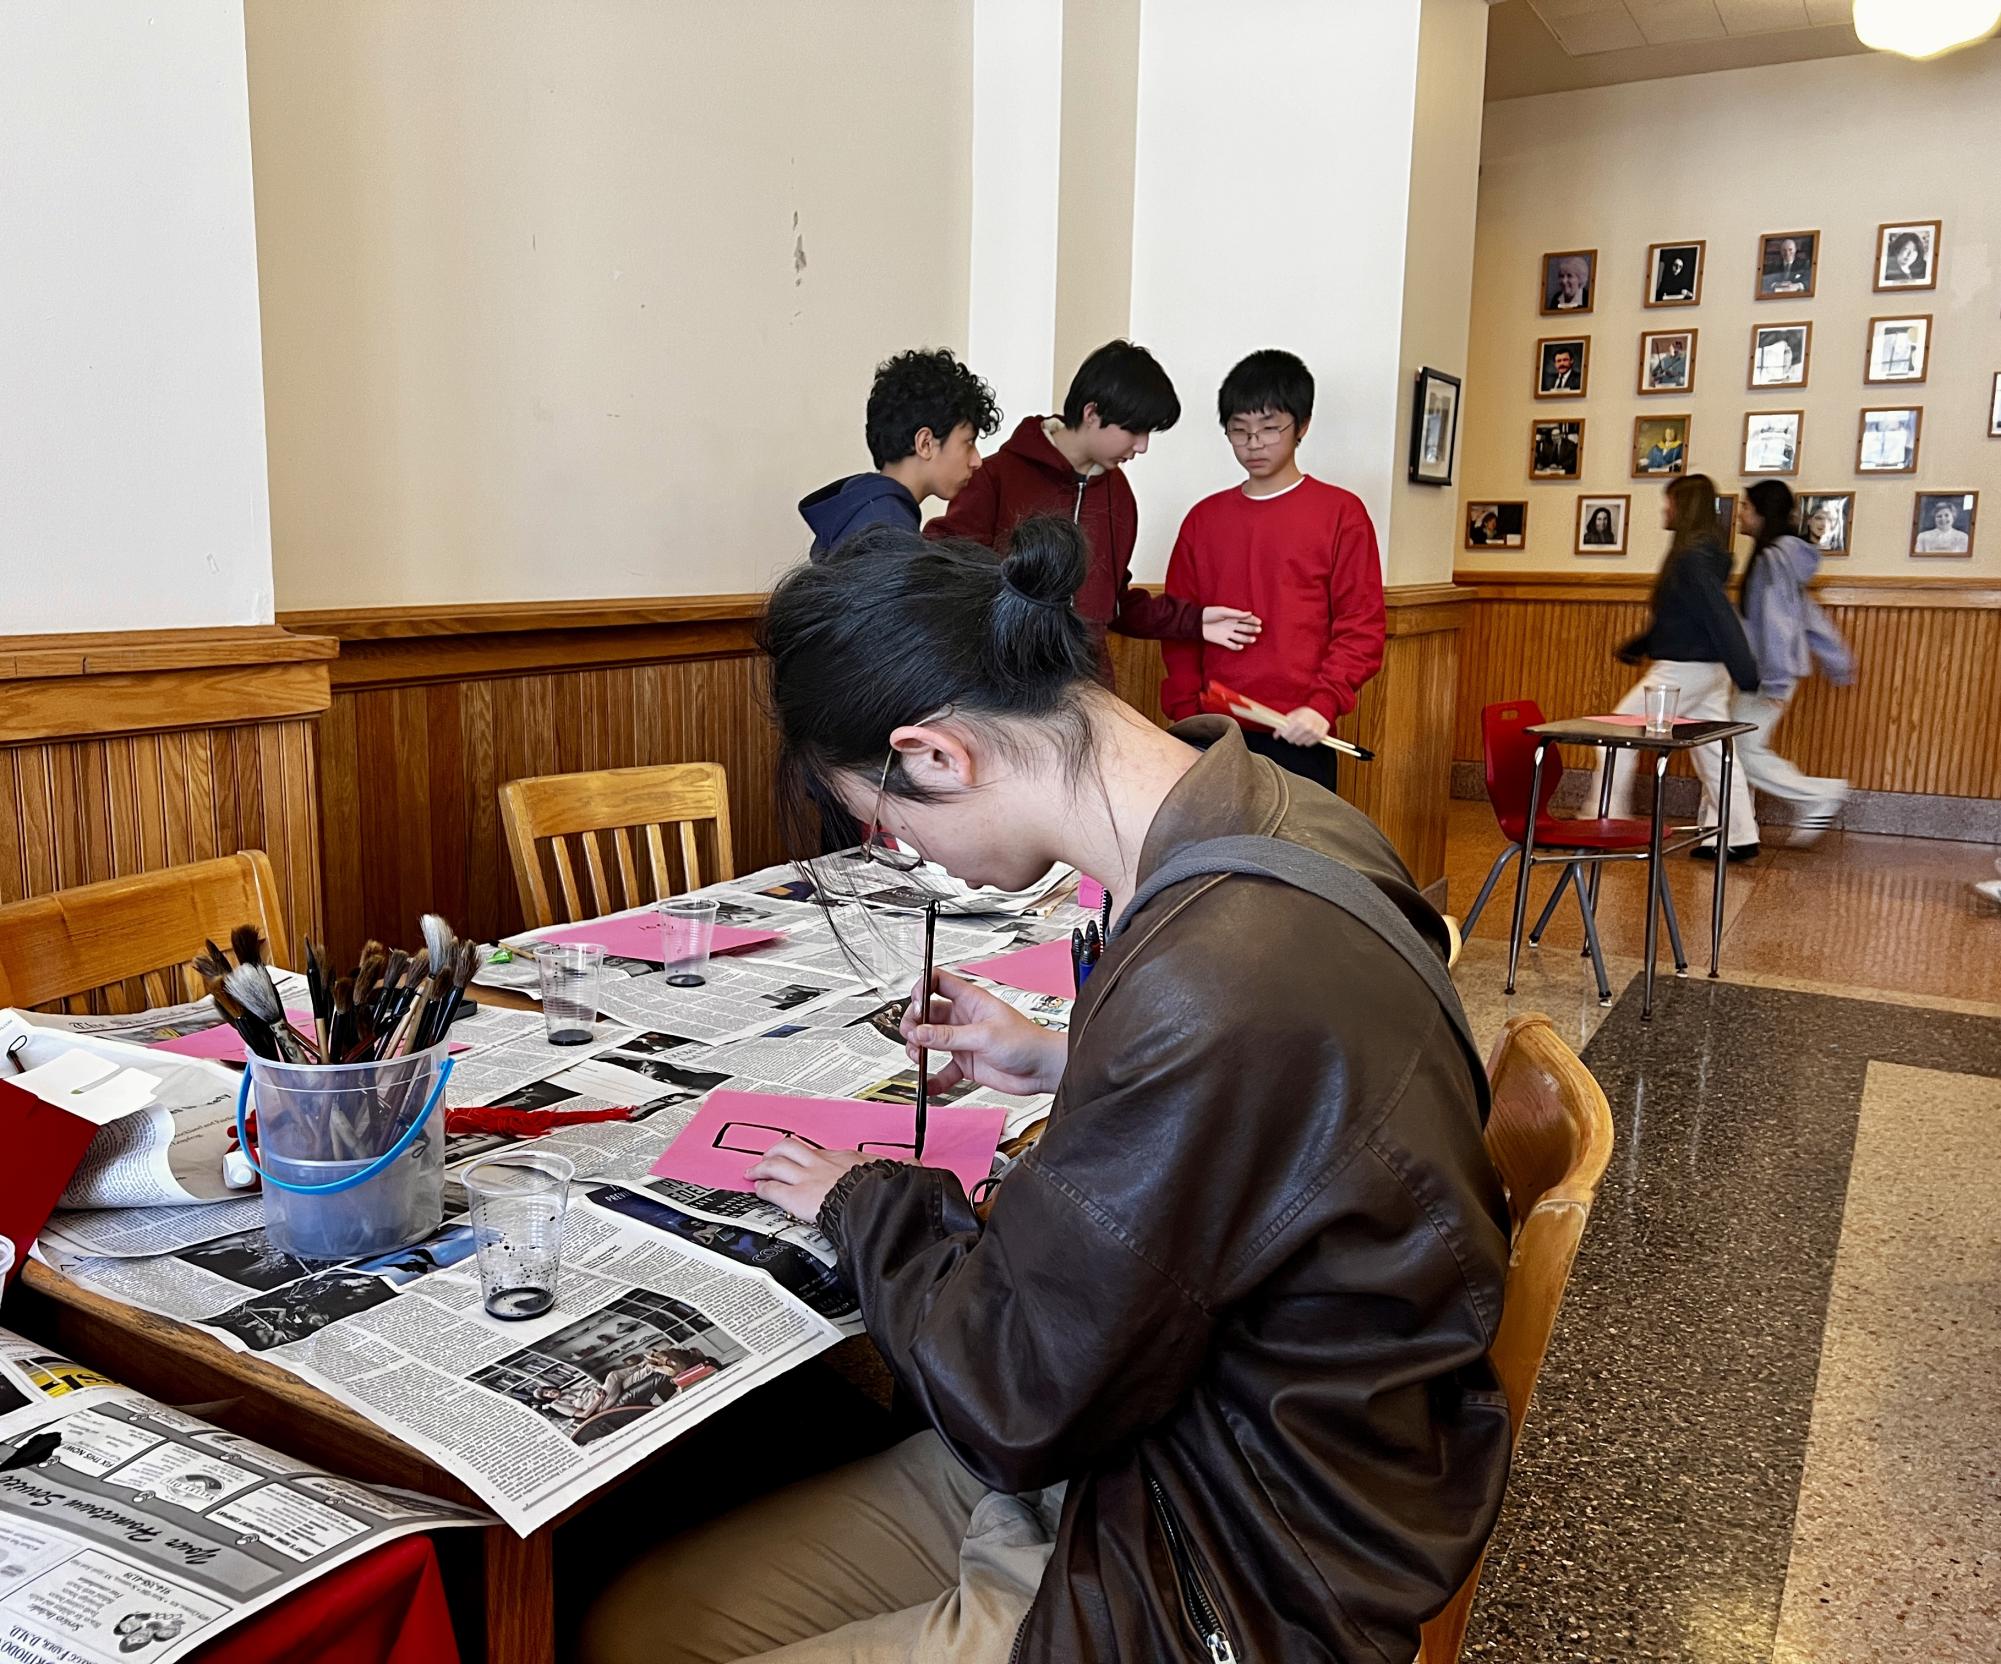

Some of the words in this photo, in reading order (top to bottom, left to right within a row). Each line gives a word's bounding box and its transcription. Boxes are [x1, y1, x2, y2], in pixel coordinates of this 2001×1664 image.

[83, 1452, 103, 1463] THIS
[64, 1498, 162, 1543] Hometown
[165, 1537, 221, 1565] Your
